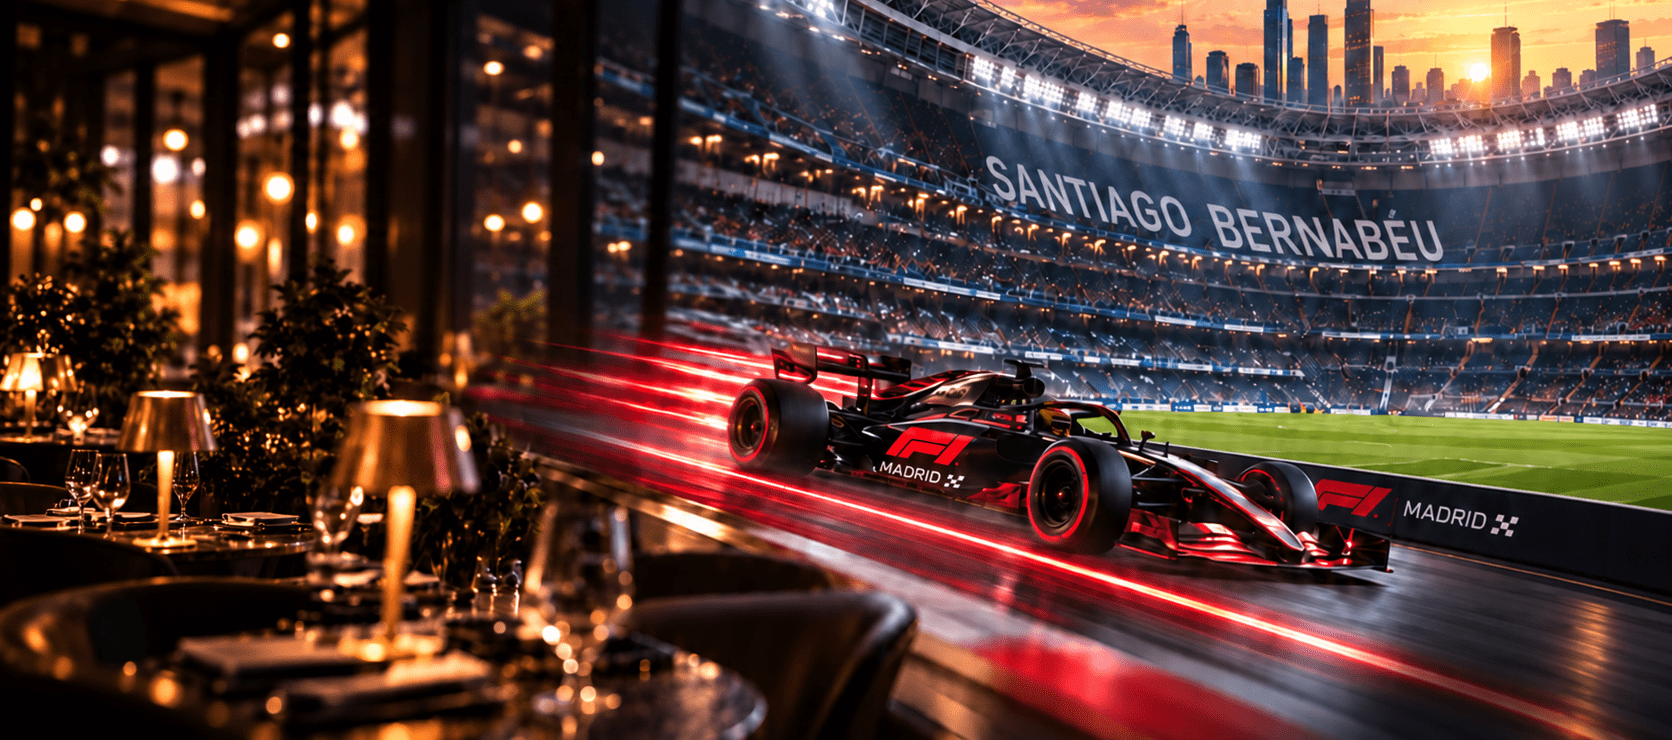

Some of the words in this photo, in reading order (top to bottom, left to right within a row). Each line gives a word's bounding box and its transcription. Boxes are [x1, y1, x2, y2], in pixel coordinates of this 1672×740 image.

[985, 155, 1192, 237] SANTIAGO
[1206, 203, 1444, 262] BERNABÉU
[886, 426, 975, 465] F1
[879, 460, 942, 484] MADRID
[1316, 478, 1392, 518] F1
[1404, 500, 1487, 530] MADRID
